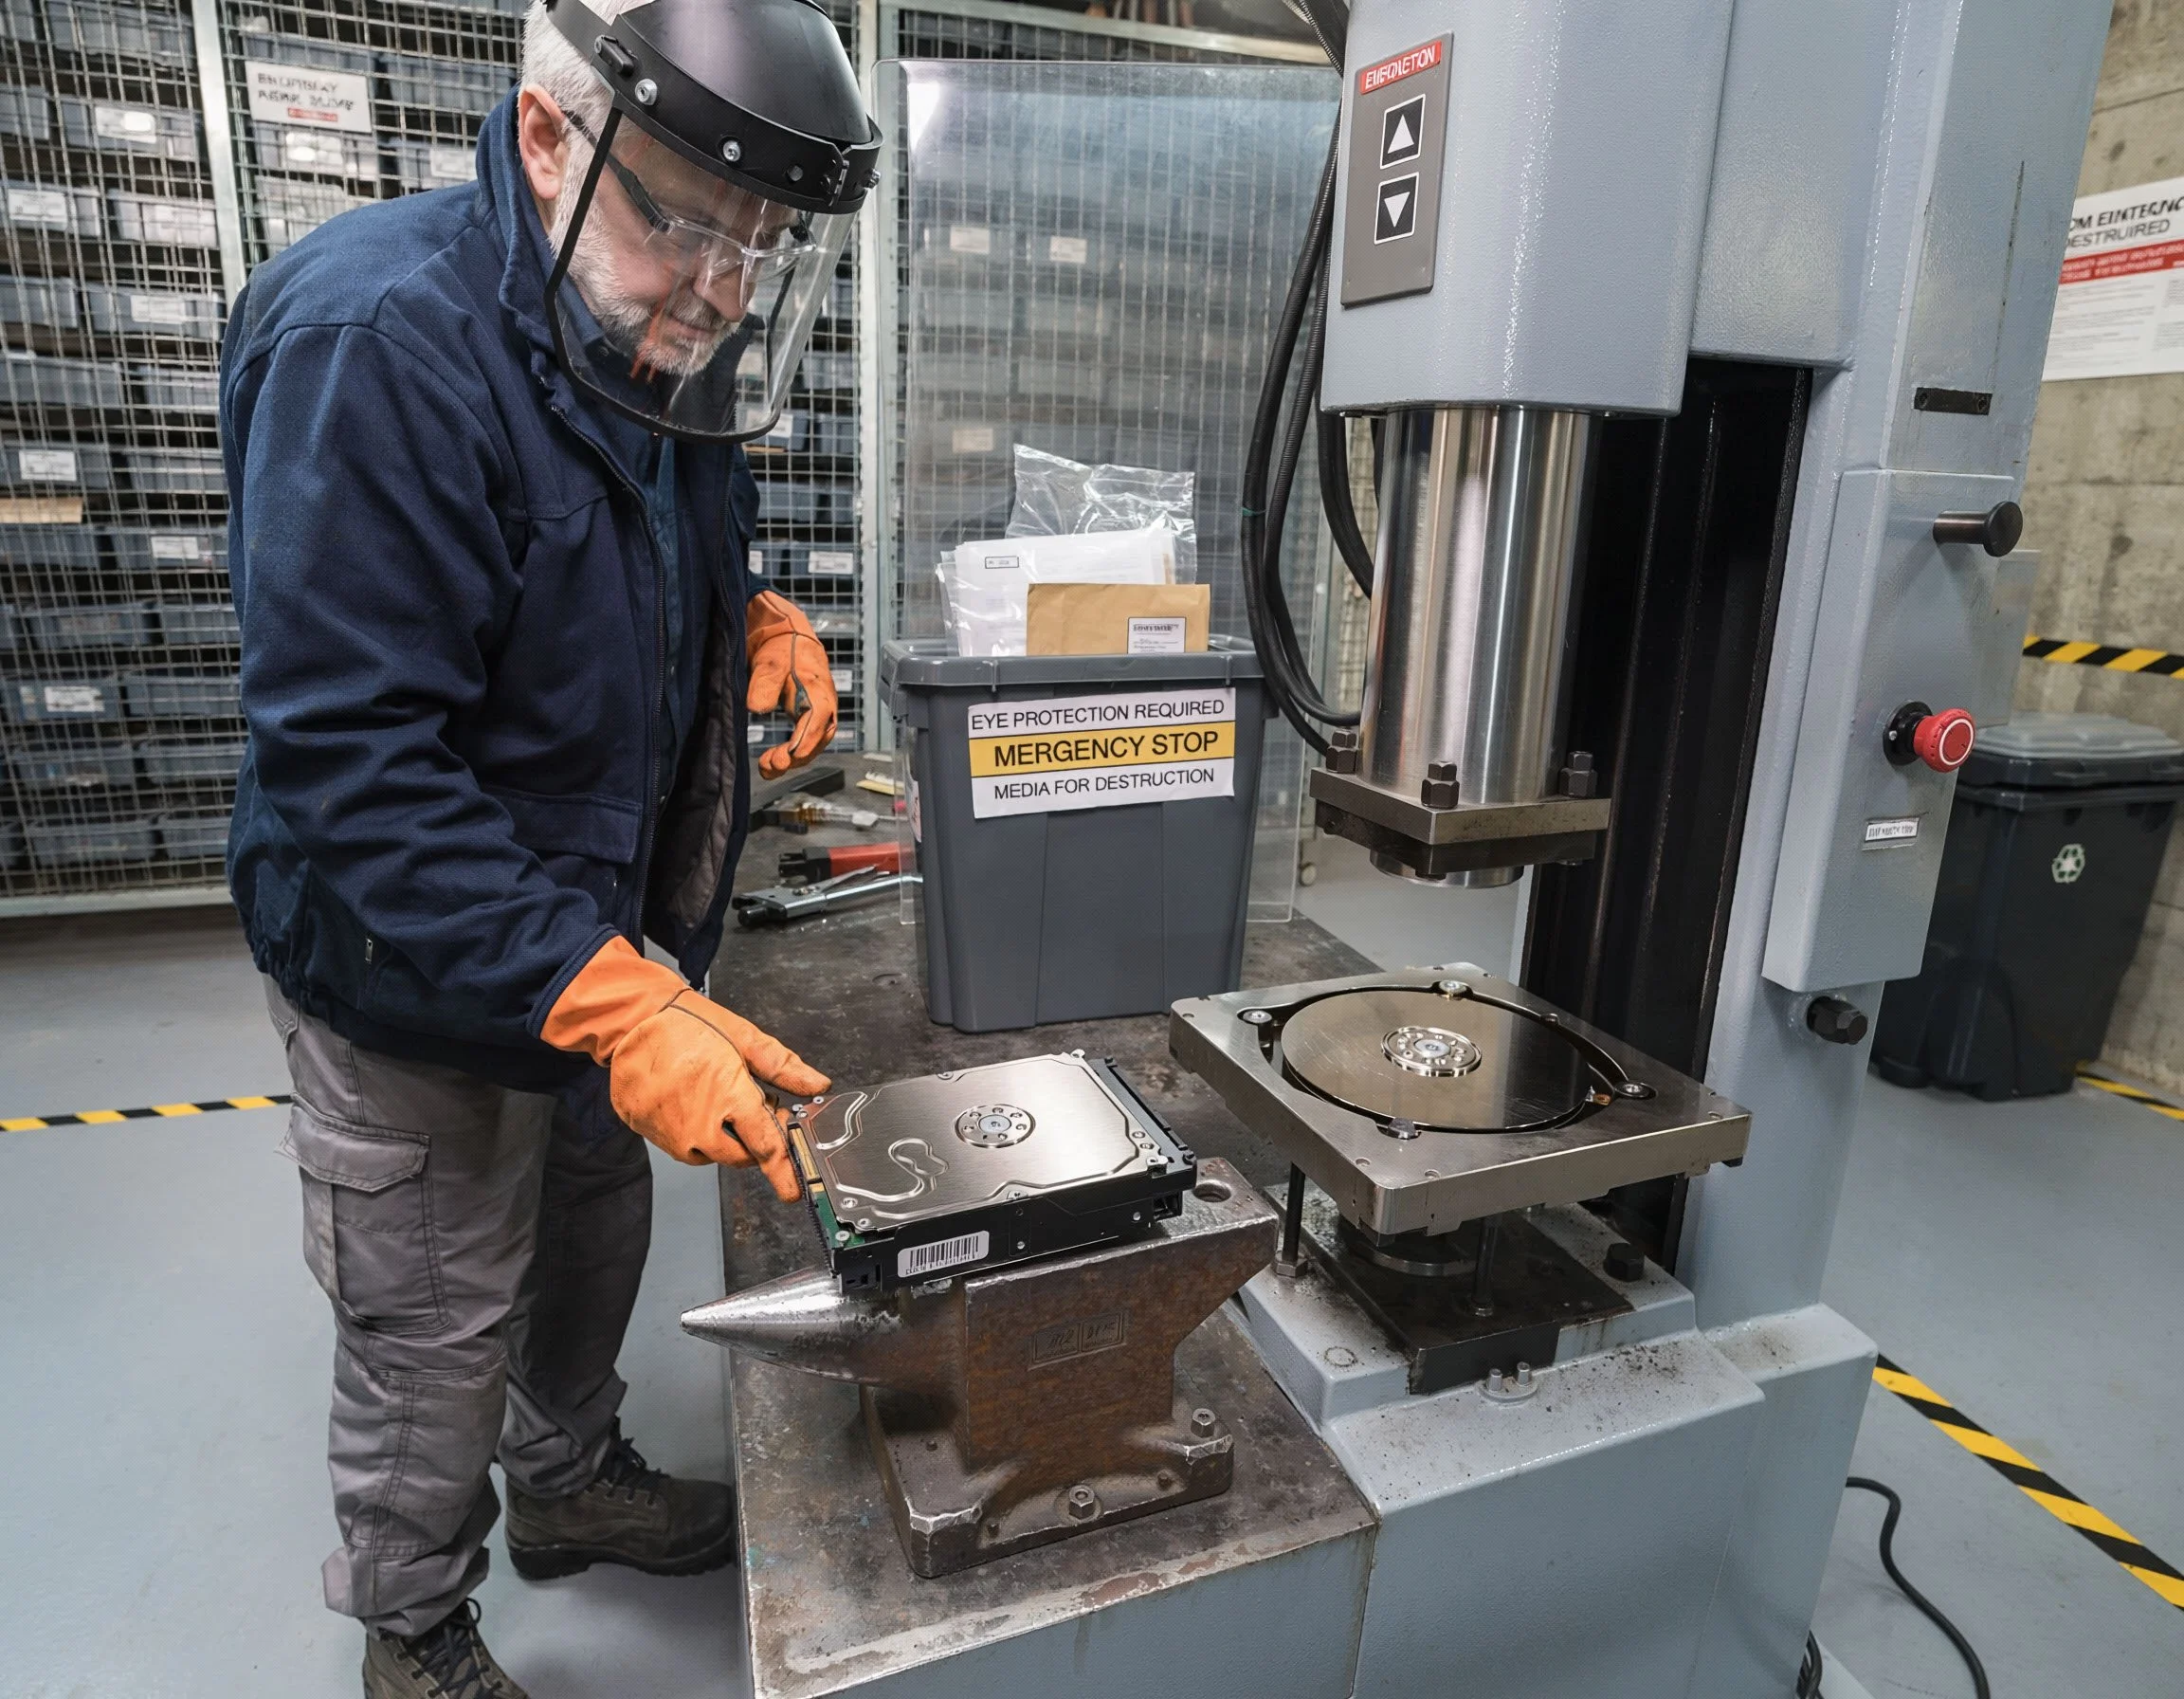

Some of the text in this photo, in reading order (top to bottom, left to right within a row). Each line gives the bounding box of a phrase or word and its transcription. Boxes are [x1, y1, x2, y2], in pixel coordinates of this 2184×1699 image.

[972, 700, 1225, 730] EYE PROTECTION REQUIRED
[994, 731, 1218, 767] MERGENCY STOP
[994, 768, 1214, 800] MEDIA FOR DESTRUCTION
